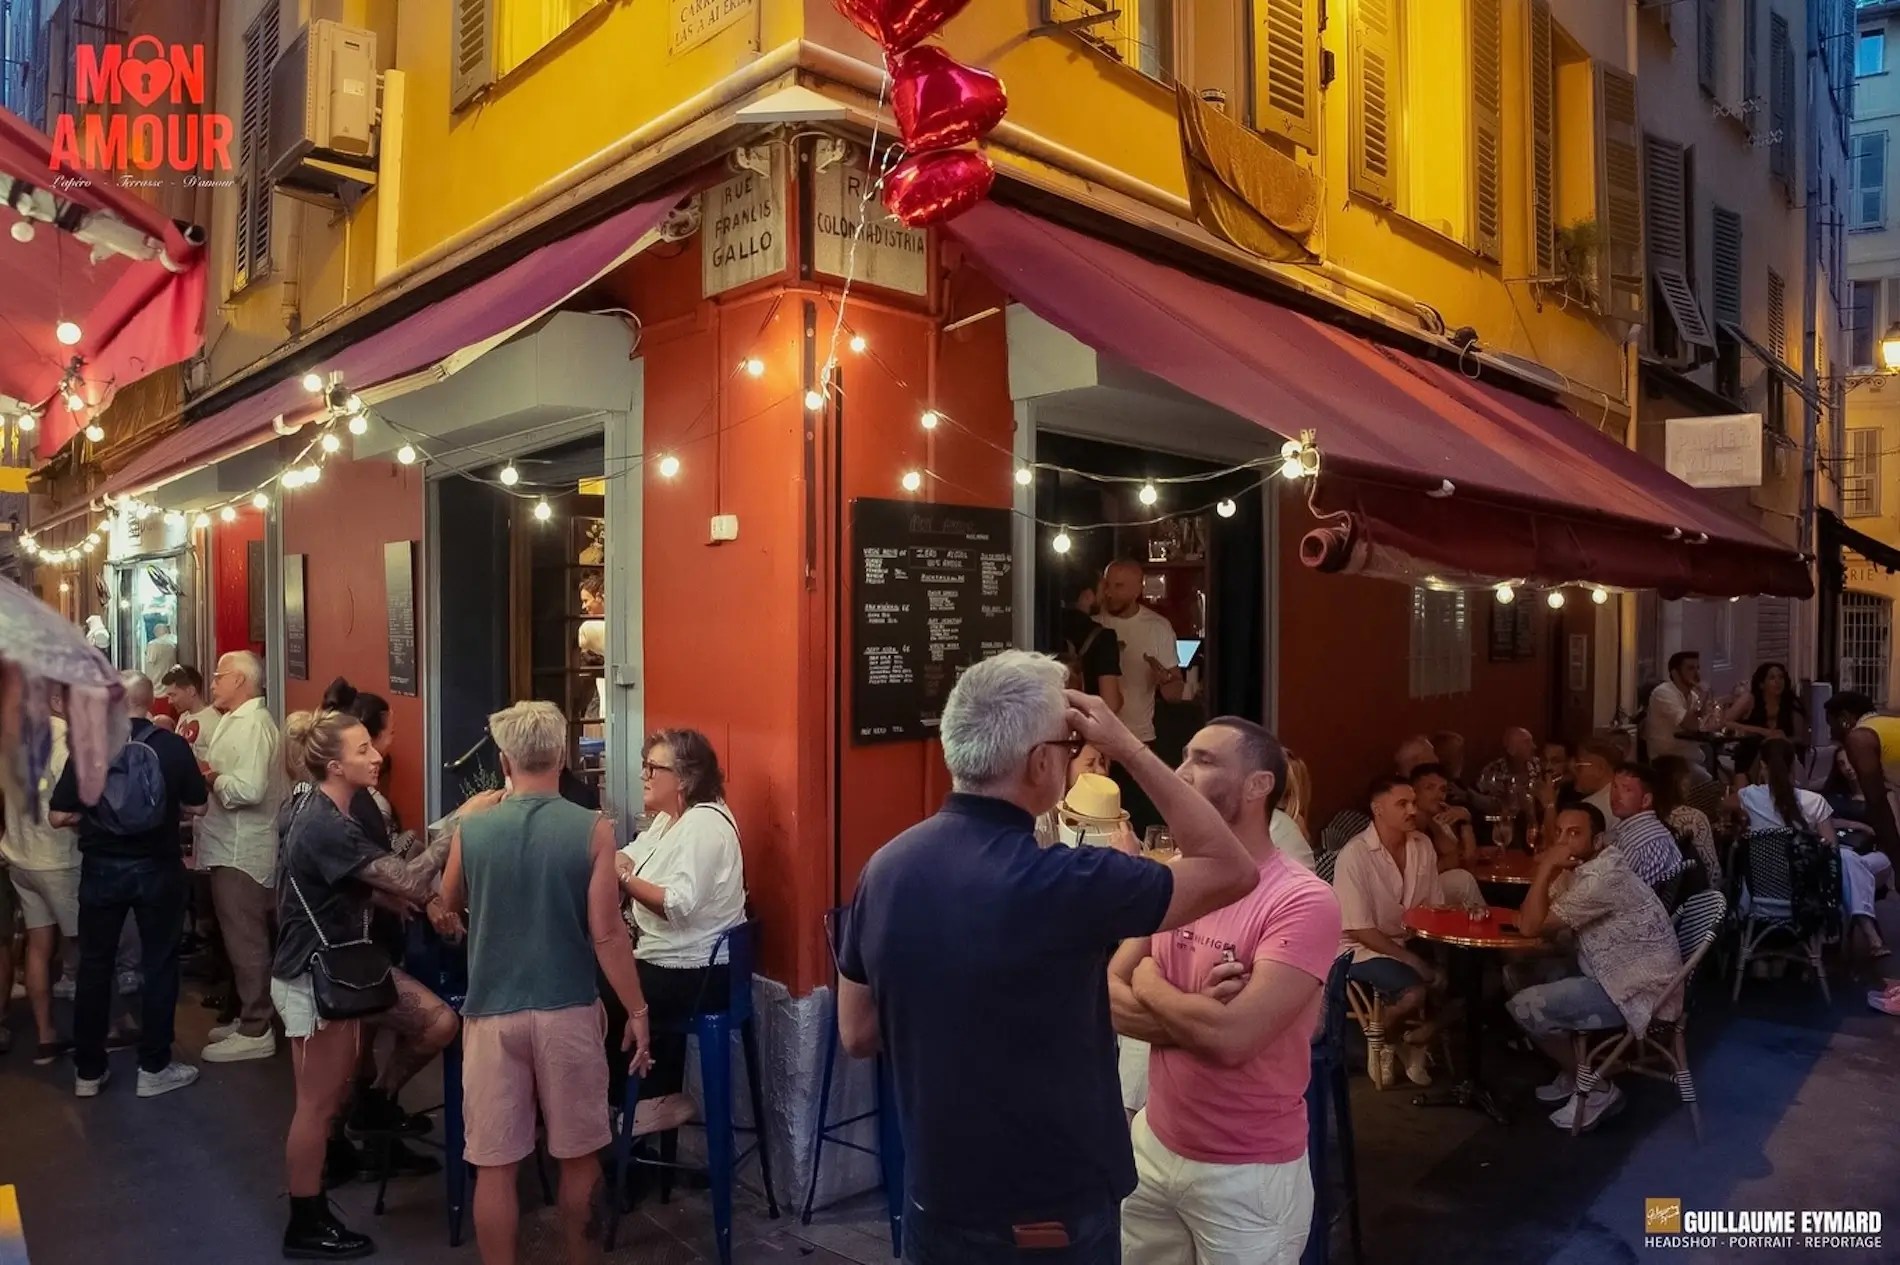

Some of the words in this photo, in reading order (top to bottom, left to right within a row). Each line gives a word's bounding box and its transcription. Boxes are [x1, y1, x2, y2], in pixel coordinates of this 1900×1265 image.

[725, 177, 753, 204] RUE
[848, 176, 884, 206] RU
[715, 200, 772, 239] FRANCIS
[712, 231, 772, 268] GALLO
